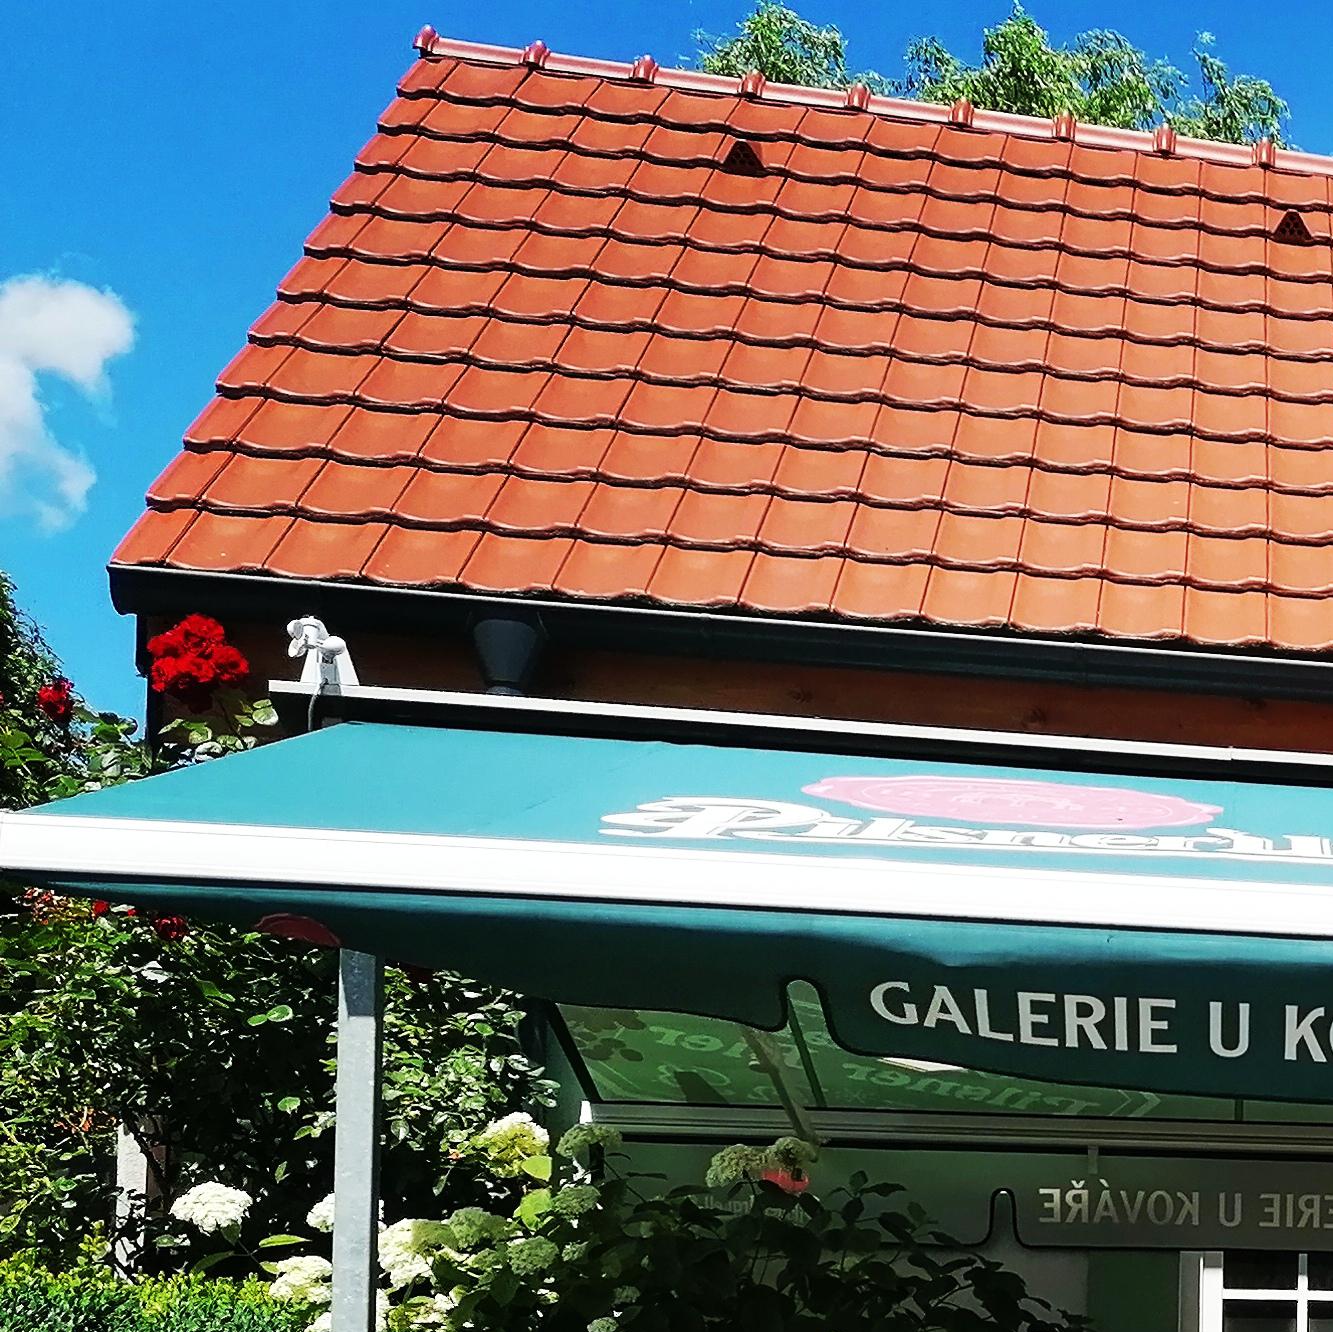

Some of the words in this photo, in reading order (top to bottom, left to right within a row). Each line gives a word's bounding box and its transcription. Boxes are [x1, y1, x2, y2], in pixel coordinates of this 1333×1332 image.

[599, 796, 1212, 852] Pilsner
[870, 980, 1178, 1054] GALERIE
[1209, 1001, 1250, 1058] U
